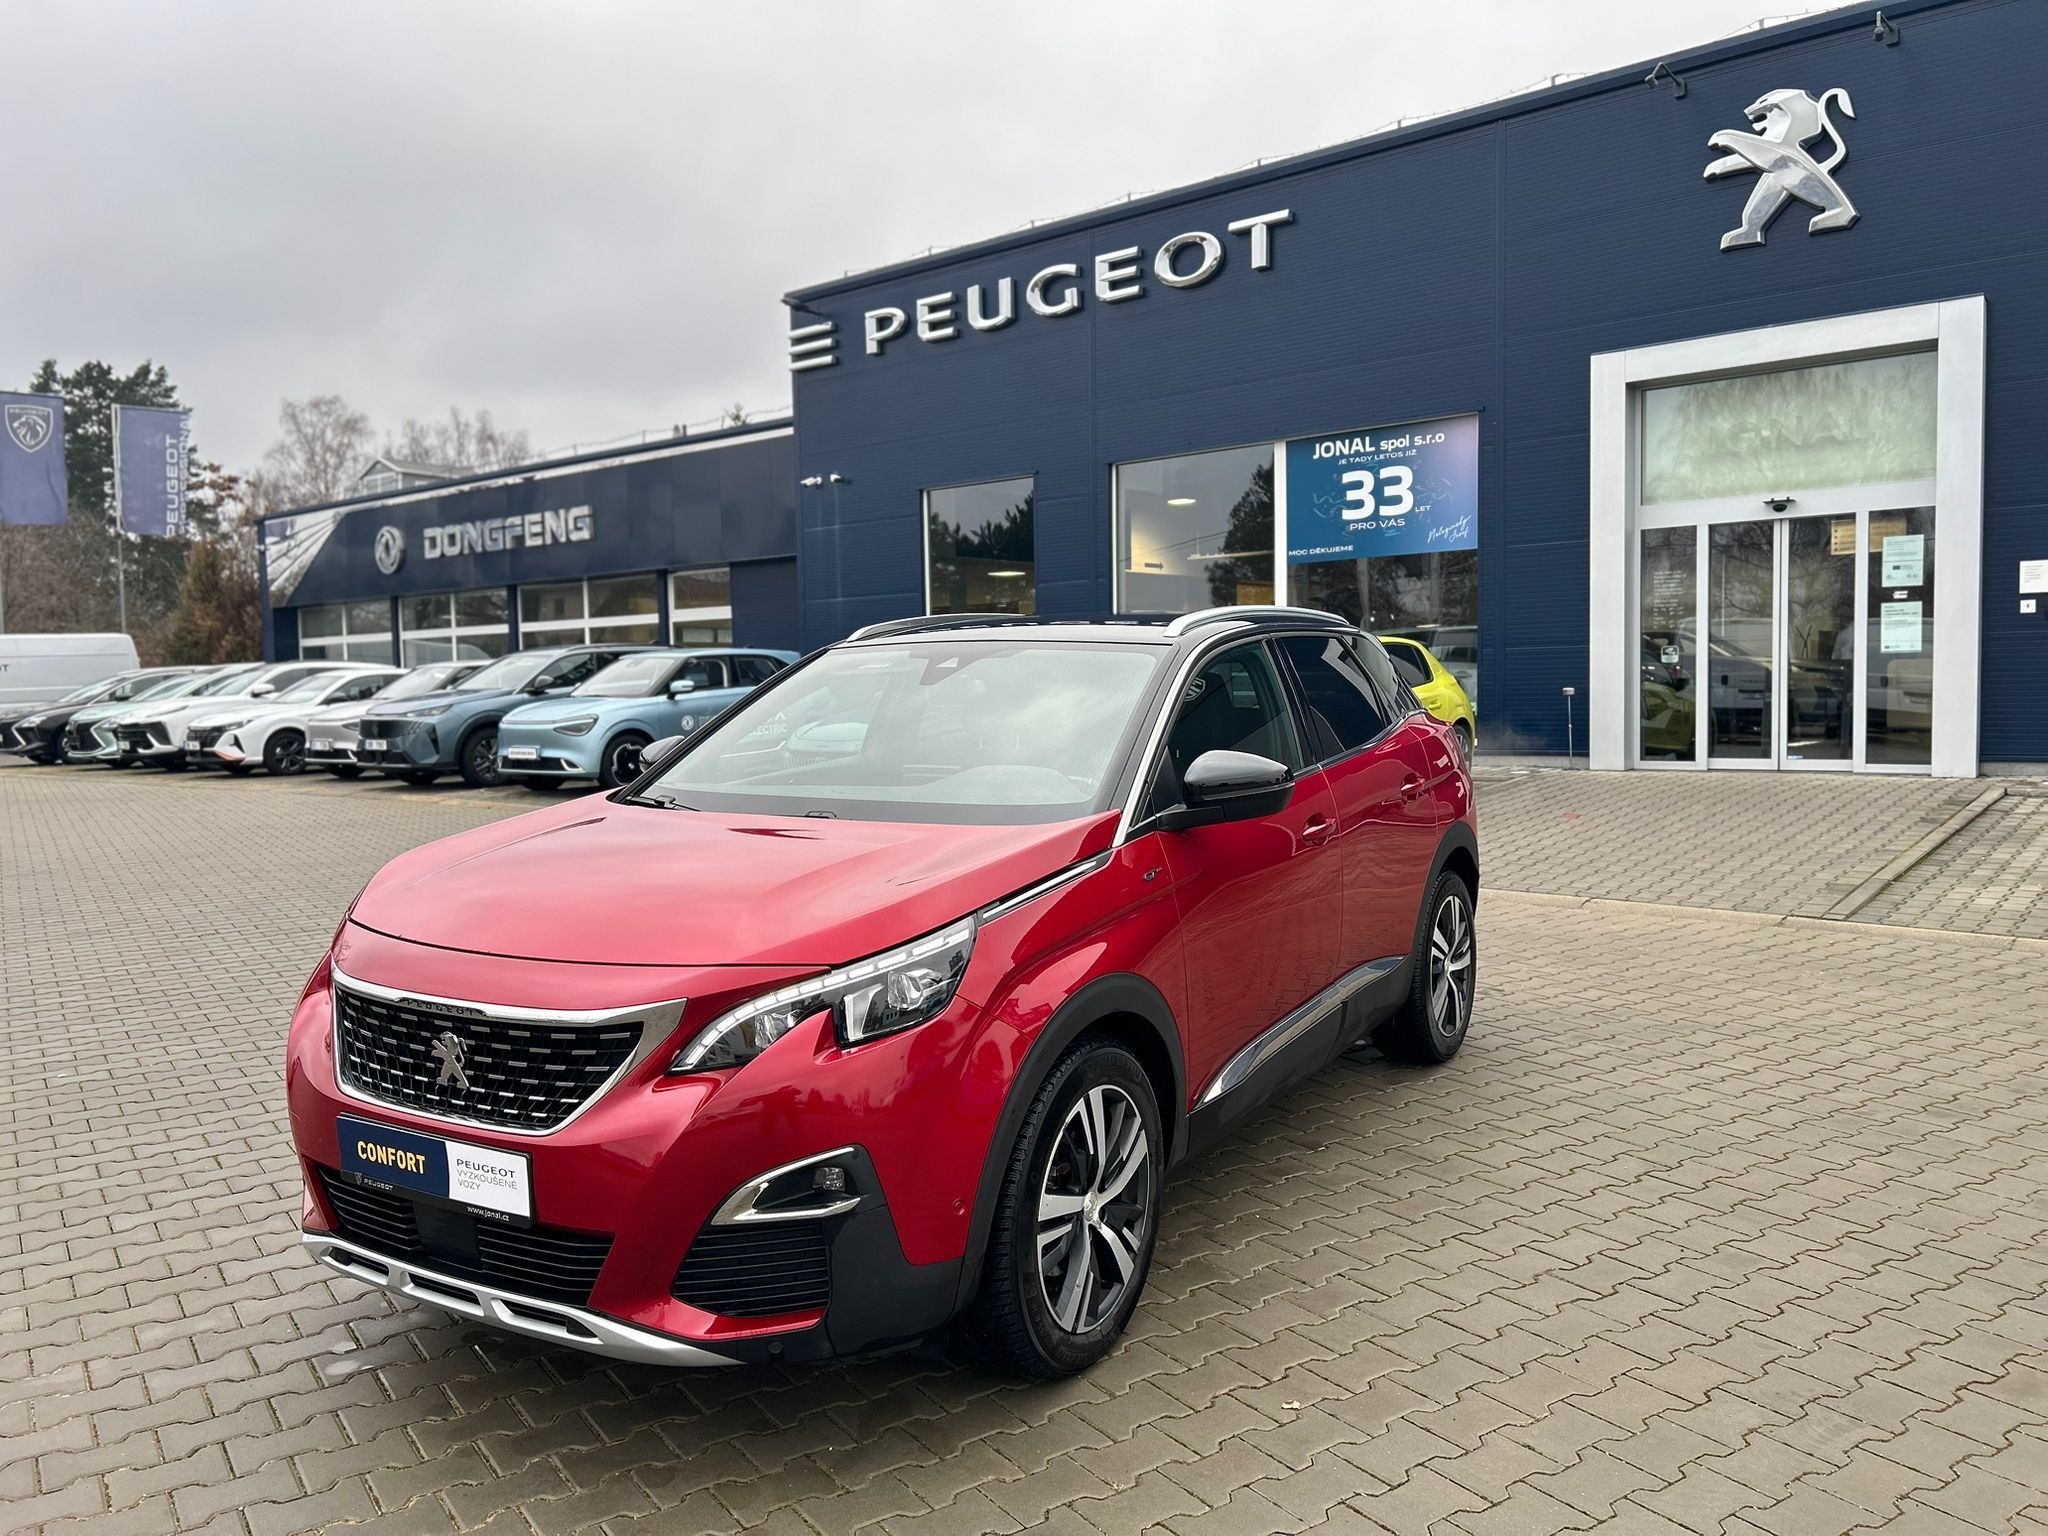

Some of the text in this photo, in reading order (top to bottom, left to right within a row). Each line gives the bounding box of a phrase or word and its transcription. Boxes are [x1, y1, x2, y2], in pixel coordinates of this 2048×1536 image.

[865, 208, 1293, 354] PEUGEOT
[1313, 432, 1445, 459] JONAL spol s.r.o
[1338, 457, 1347, 465] JE
[1349, 454, 1373, 464] TADY
[1375, 451, 1403, 461] LETOS
[165, 433, 179, 537] PEUGEOT
[1341, 465, 1414, 520] 33
[423, 505, 592, 559] DONGFENG
[1350, 518, 1406, 531] PRO VÁS
[406, 999, 474, 1016] PEUGEOT
[357, 1140, 426, 1174] CONFORT
[456, 1158, 516, 1179] PEUGEOT
[363, 1178, 394, 1190] PEUGEOT
[457, 1178, 480, 1190] VOZY
[466, 1206, 510, 1221] www.jonal.cz
